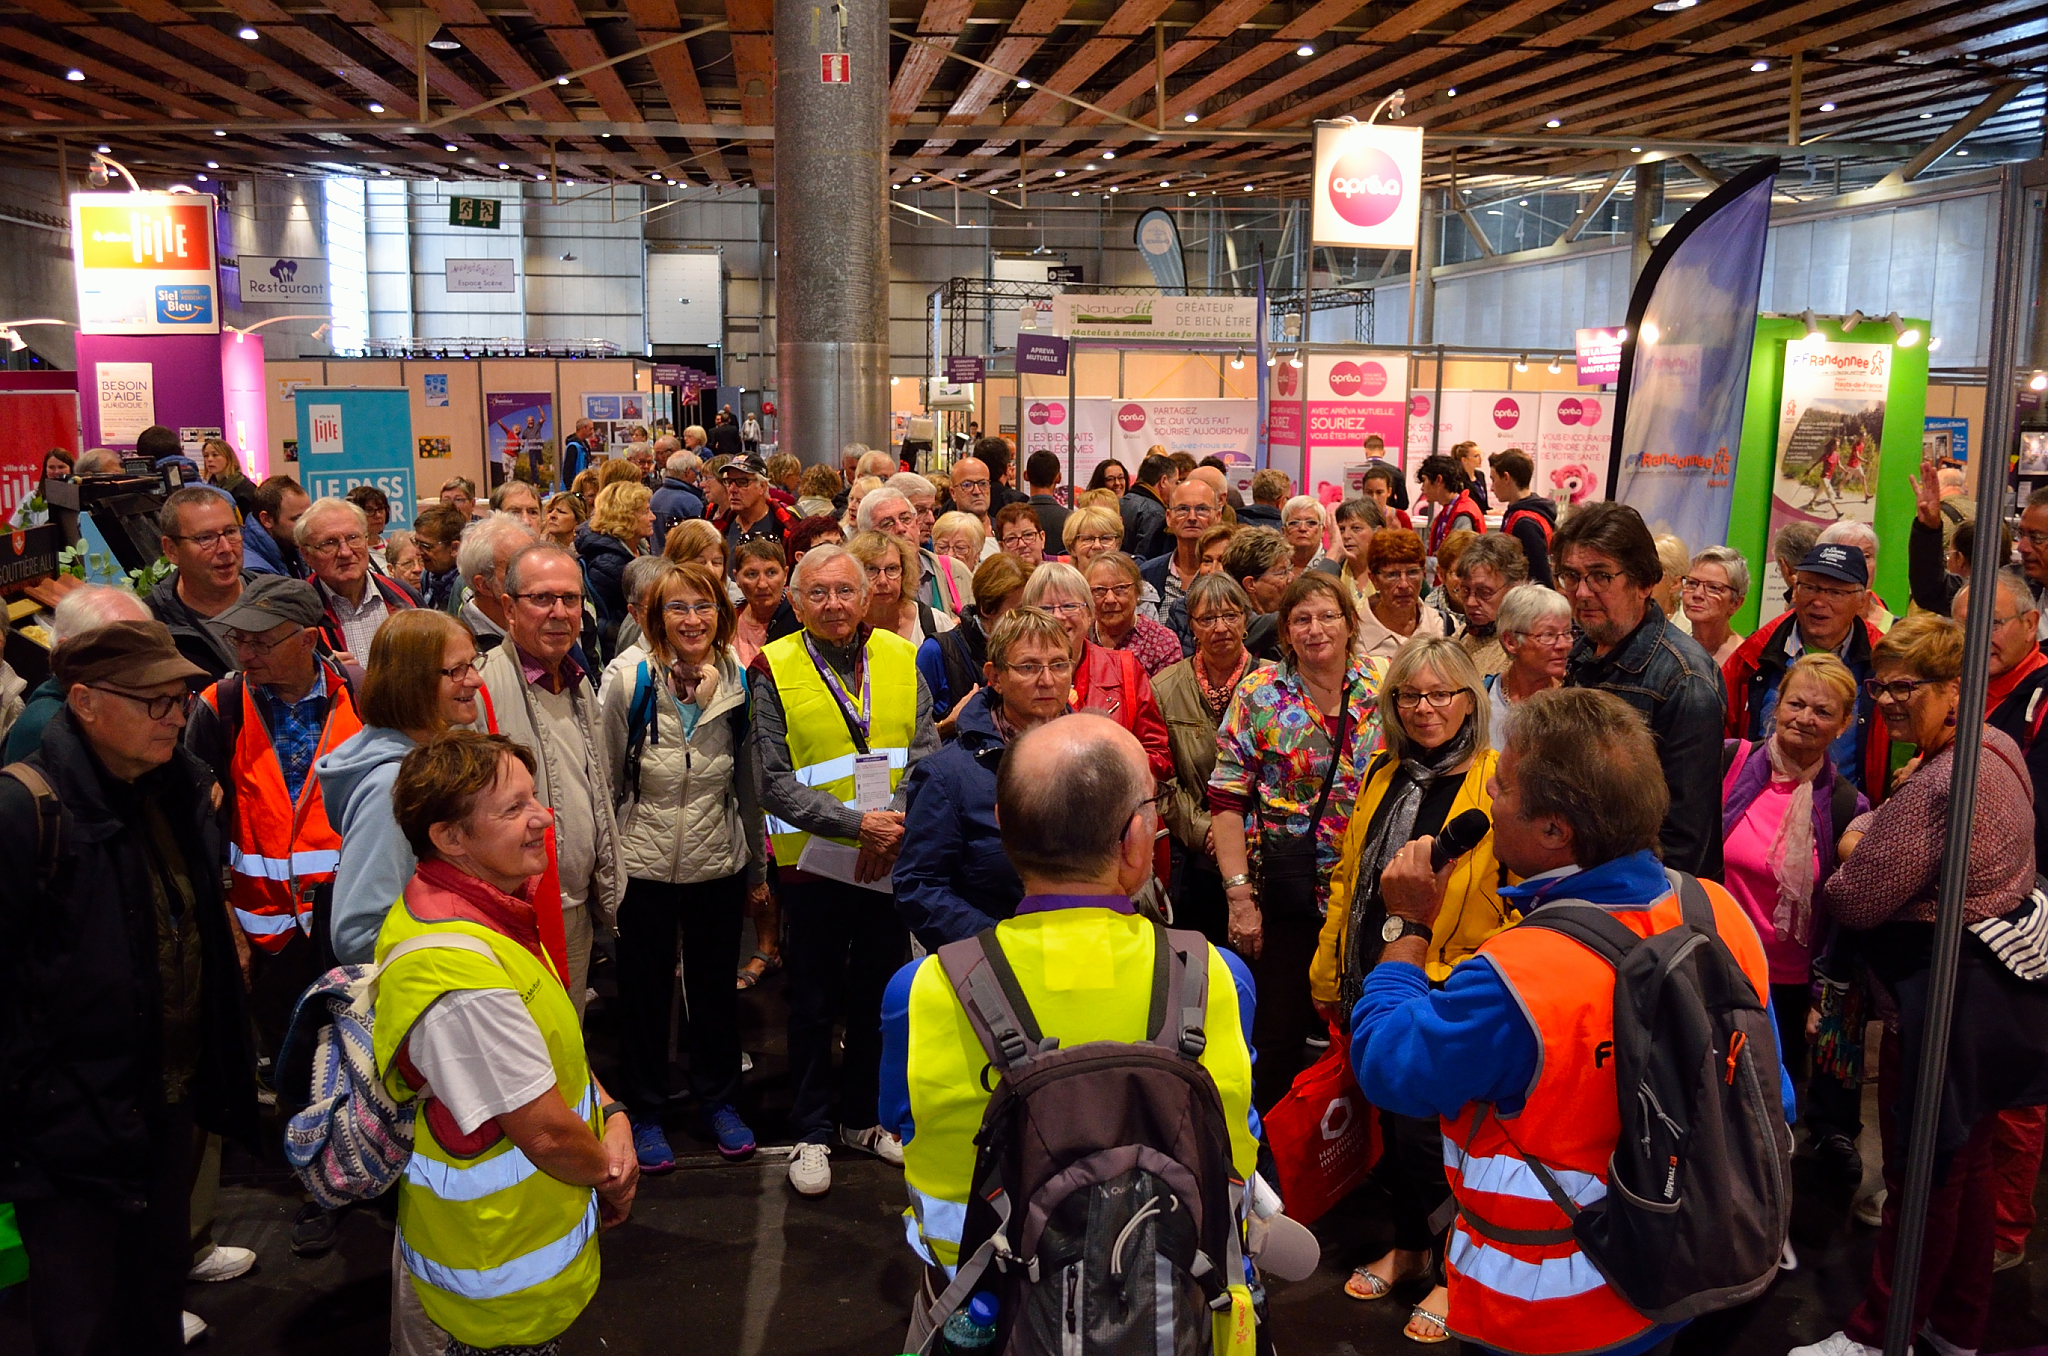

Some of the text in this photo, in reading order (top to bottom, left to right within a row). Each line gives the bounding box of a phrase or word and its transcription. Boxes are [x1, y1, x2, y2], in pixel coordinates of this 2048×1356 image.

[250, 280, 323, 294] Restaurant
[158, 290, 178, 301] Siel
[168, 301, 192, 312] Bleu
[1176, 301, 1234, 312] CRÉATEUR
[1176, 315, 1251, 326] DE BIEN ÊTRE
[1181, 330, 1210, 338] forme
[1026, 354, 1058, 362] MUTUELLE
[102, 381, 147, 390] BESOIN
[102, 392, 142, 401] D'AIDE
[1331, 406, 1356, 415] APRÉVA
[1310, 417, 1365, 430] SOURIEZ
[1419, 422, 1452, 432] SÉNOR
[1028, 433, 1093, 442] LES BIENAITS
[1330, 431, 1346, 439] ÊTES
[1028, 443, 1094, 453] DES LÉGMES
[1578, 453, 1600, 461] SANTÉ
[0, 474, 40, 515] ill
[316, 479, 340, 500] LE
[40, 553, 54, 573] ALU
